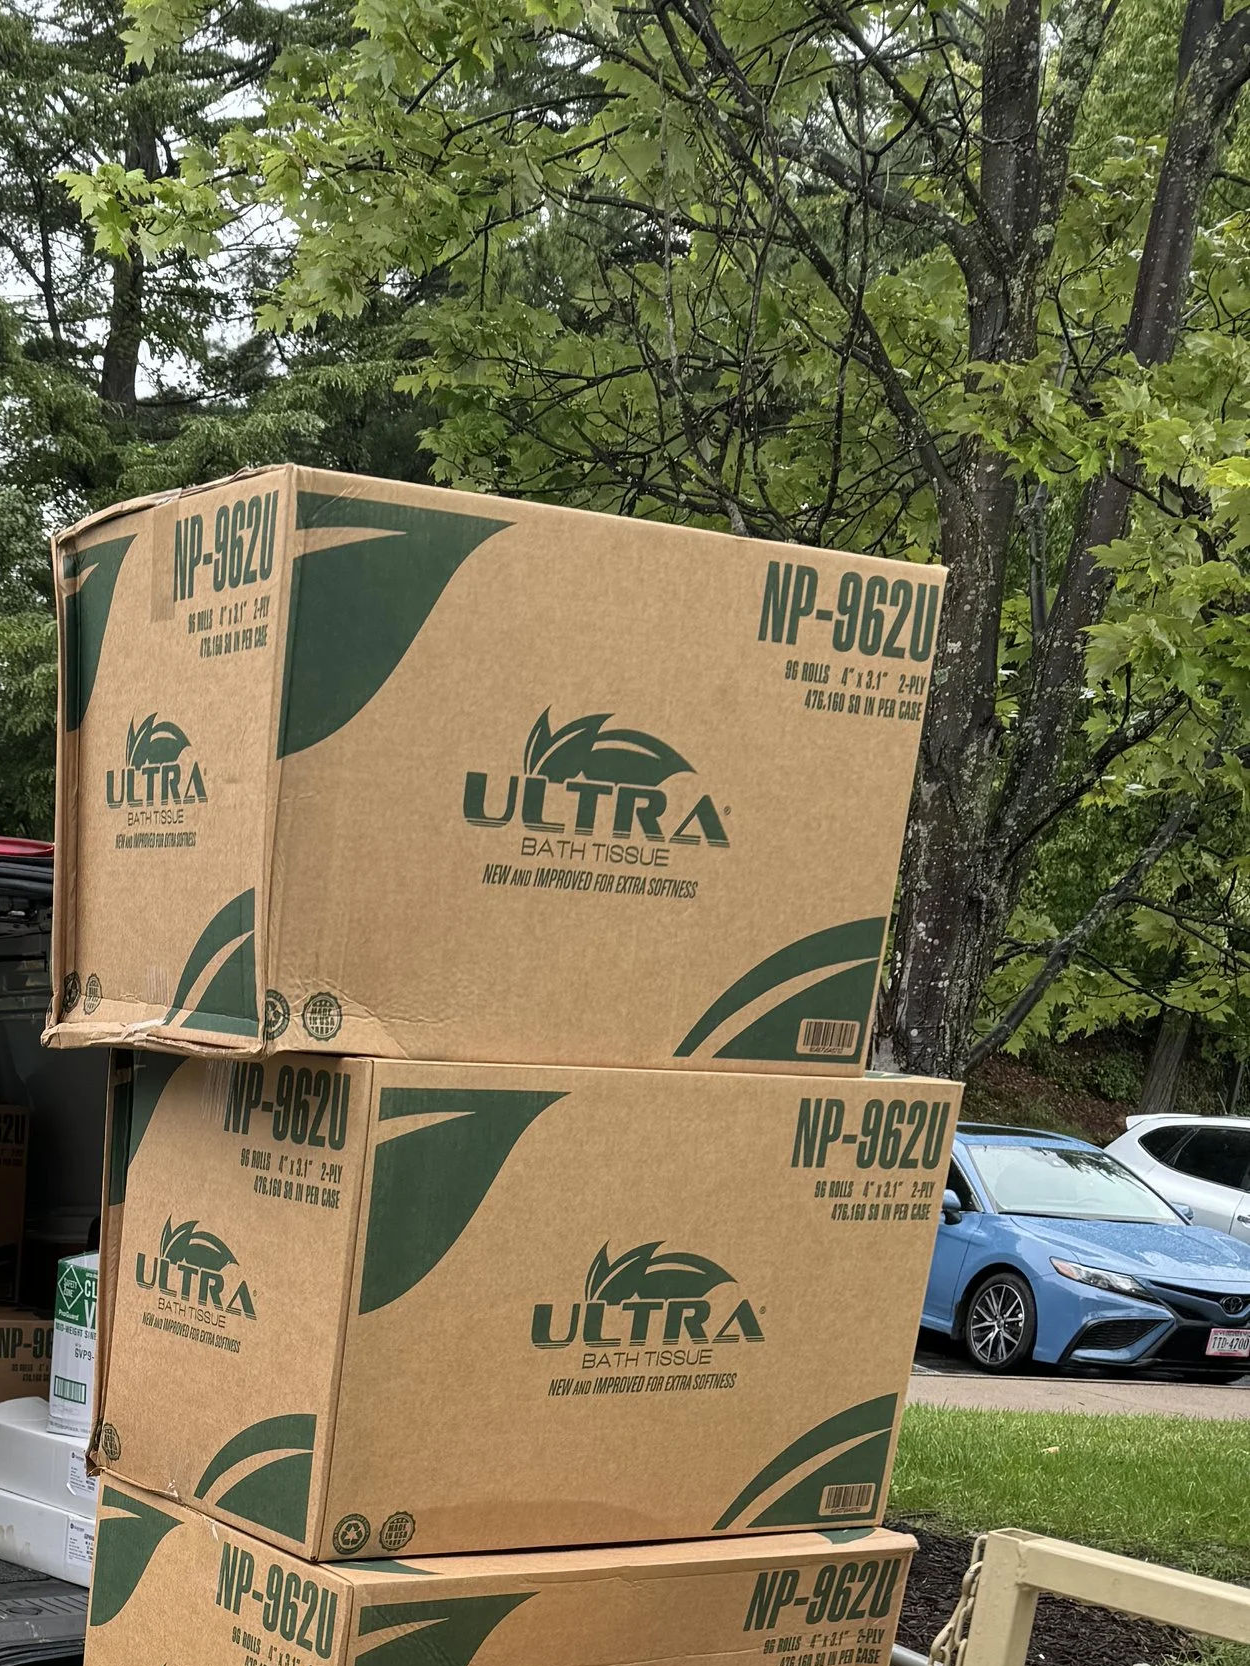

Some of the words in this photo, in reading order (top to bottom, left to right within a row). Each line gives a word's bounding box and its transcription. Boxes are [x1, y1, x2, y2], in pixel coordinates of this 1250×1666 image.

[174, 489, 278, 603] NP-962U
[758, 560, 939, 663] NP-962U
[785, 660, 799, 680] 96
[802, 662, 830, 684] ROLLS
[898, 674, 927, 695] 2-PLY
[848, 695, 861, 715] SQ
[864, 696, 874, 716] IN
[878, 698, 895, 718] PER
[898, 701, 922, 721] CASE
[107, 762, 208, 807] ULTRA
[128, 811, 151, 825] BATH
[153, 809, 183, 825] TISSUE
[463, 772, 730, 848] ULTRA
[521, 837, 586, 860] BATH
[591, 843, 670, 866] TISSUE
[482, 864, 511, 885] NEW
[511, 870, 532, 887] AND
[533, 868, 593, 891] IMPROVED
[593, 874, 615, 893] FOR
[615, 876, 646, 895] EXTRA
[647, 878, 698, 899] SOFTNESS
[225, 1061, 350, 1150] NP-962U
[792, 1098, 950, 1170] NP-962U
[252, 1149, 272, 1171] ROLLS
[295, 1183, 303, 1203] IN
[306, 1185, 319, 1206] PER
[321, 1189, 340, 1210] CASE
[814, 1181, 826, 1197] 96
[828, 1181, 853, 1198] ROLLS
[911, 1182, 936, 1198] 2-PLY
[867, 1204, 879, 1220] SQ
[881, 1204, 889, 1220] IN
[892, 1205, 908, 1220] PER
[910, 1205, 931, 1220] CASE
[136, 1253, 257, 1320] ULTRA
[159, 1297, 187, 1317] BATH
[189, 1306, 226, 1328] TISSUE
[532, 1299, 765, 1346] ULTRA
[190, 1327, 200, 1341] FOR
[200, 1330, 215, 1346] EXTRA
[582, 1351, 638, 1368] BATH
[643, 1348, 712, 1367] TISSUE
[549, 1378, 573, 1395] NEW
[593, 1376, 645, 1394] IMPROVED
[645, 1376, 664, 1392] FOR
[665, 1376, 692, 1391] EXTRA
[693, 1374, 738, 1391] SOFTNESS
[216, 1541, 338, 1662] NP-962U
[744, 1559, 901, 1630] NP-962U
[243, 1631, 262, 1655] ROLLS
[839, 1649, 854, 1664] PER
[856, 1648, 881, 1664] CASE
